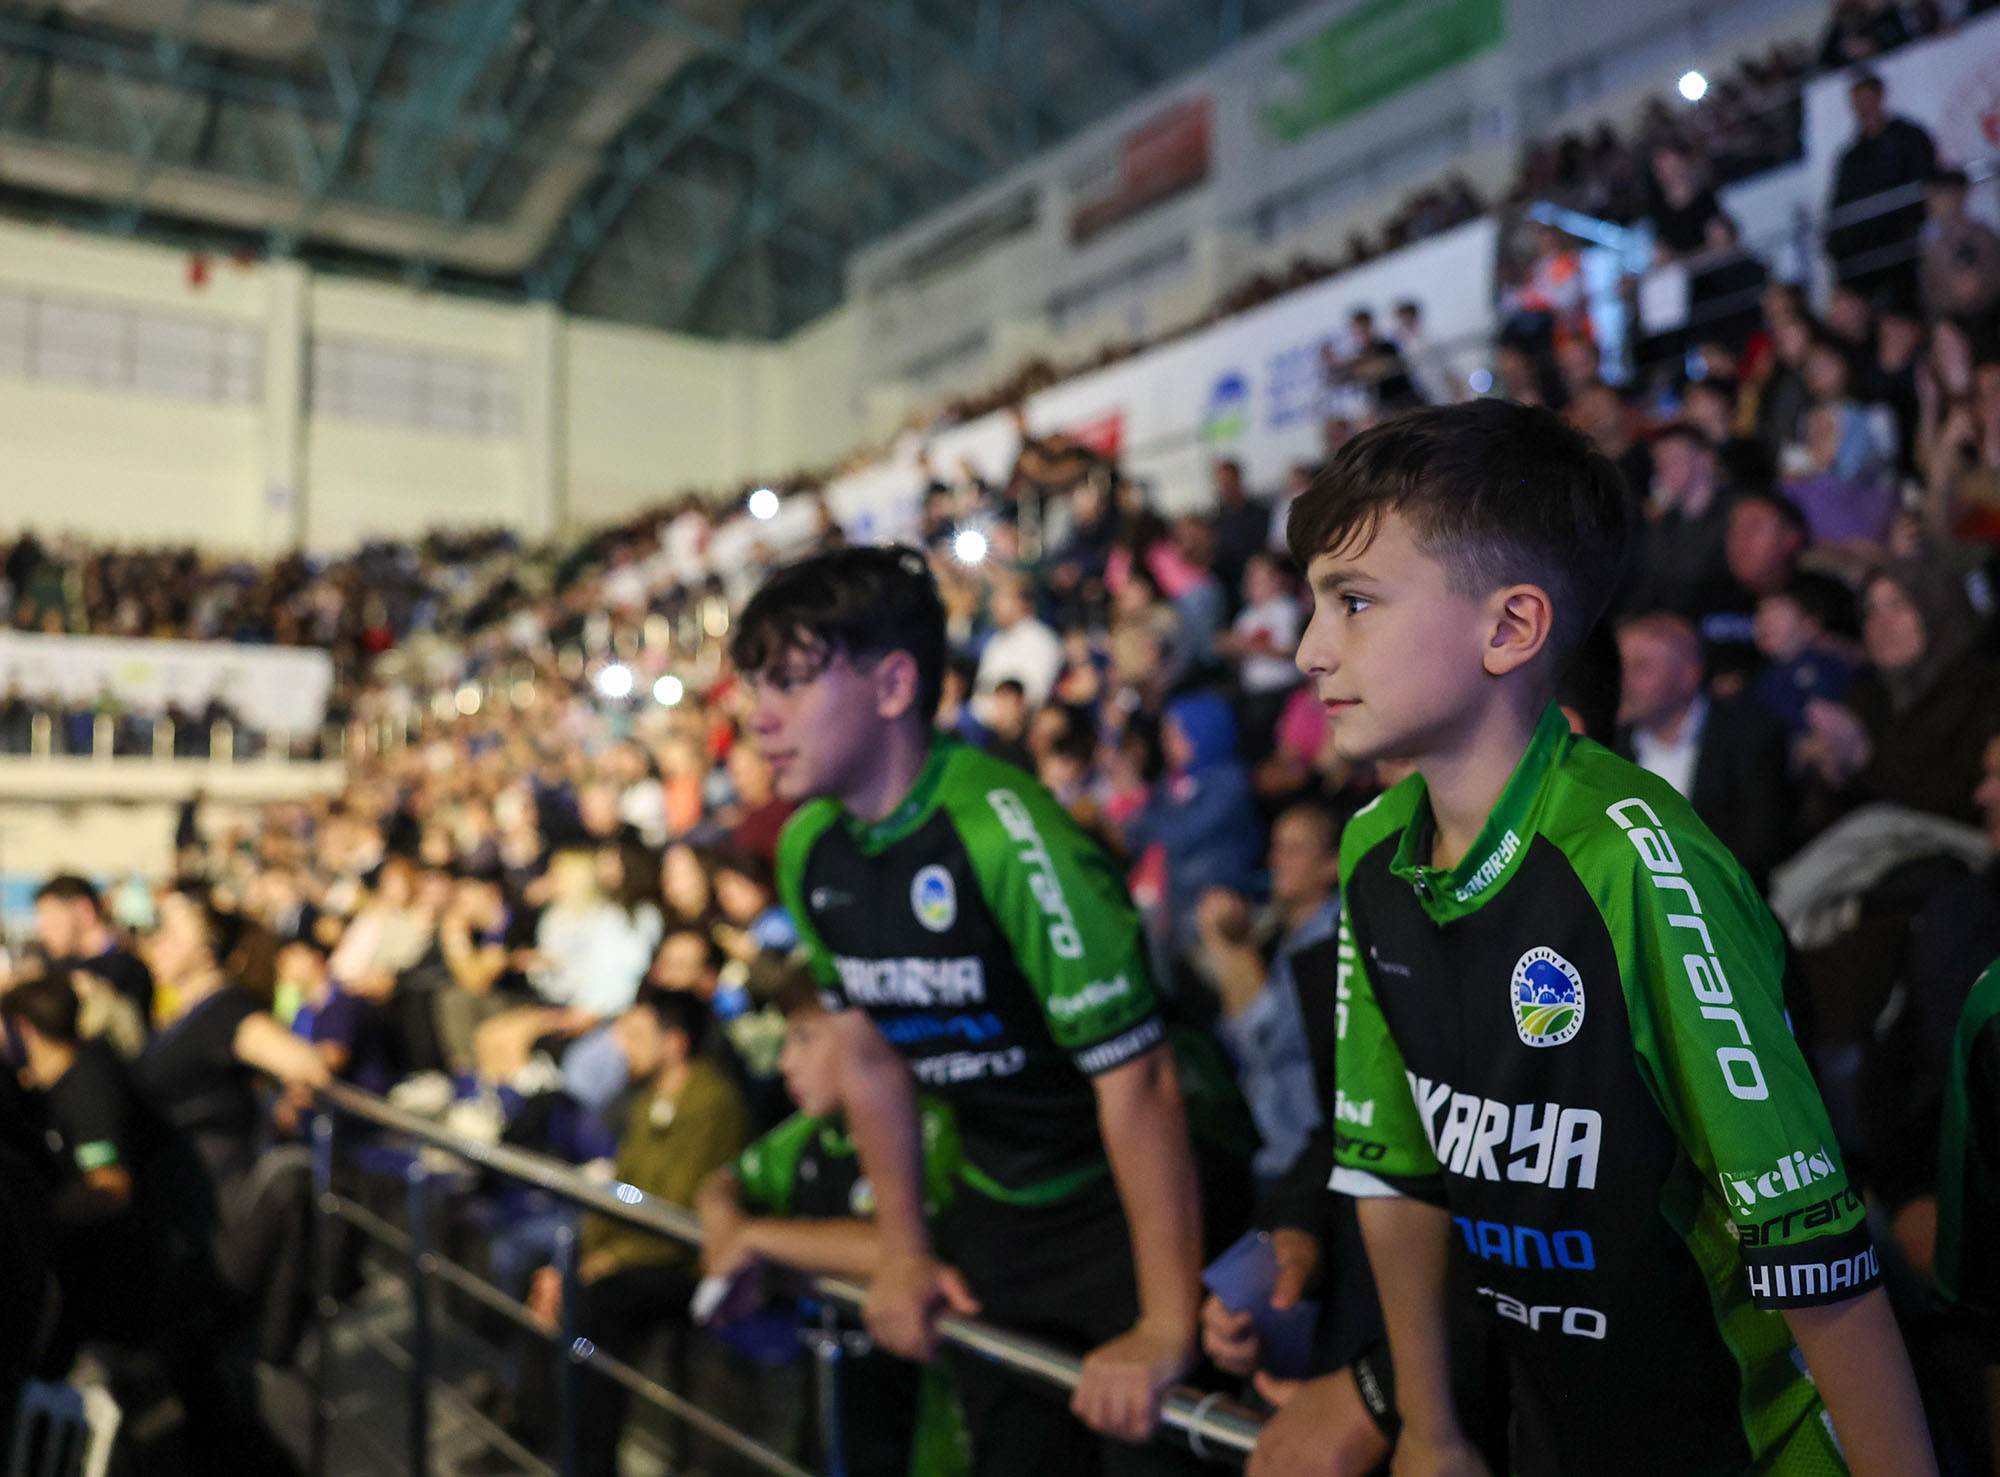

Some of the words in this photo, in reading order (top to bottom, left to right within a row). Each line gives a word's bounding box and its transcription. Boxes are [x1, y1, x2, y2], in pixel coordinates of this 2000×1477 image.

[1605, 797, 1769, 1100] carraro
[1737, 1186, 1858, 1249] arraro
[1745, 1243, 1880, 1297] HIMANO
